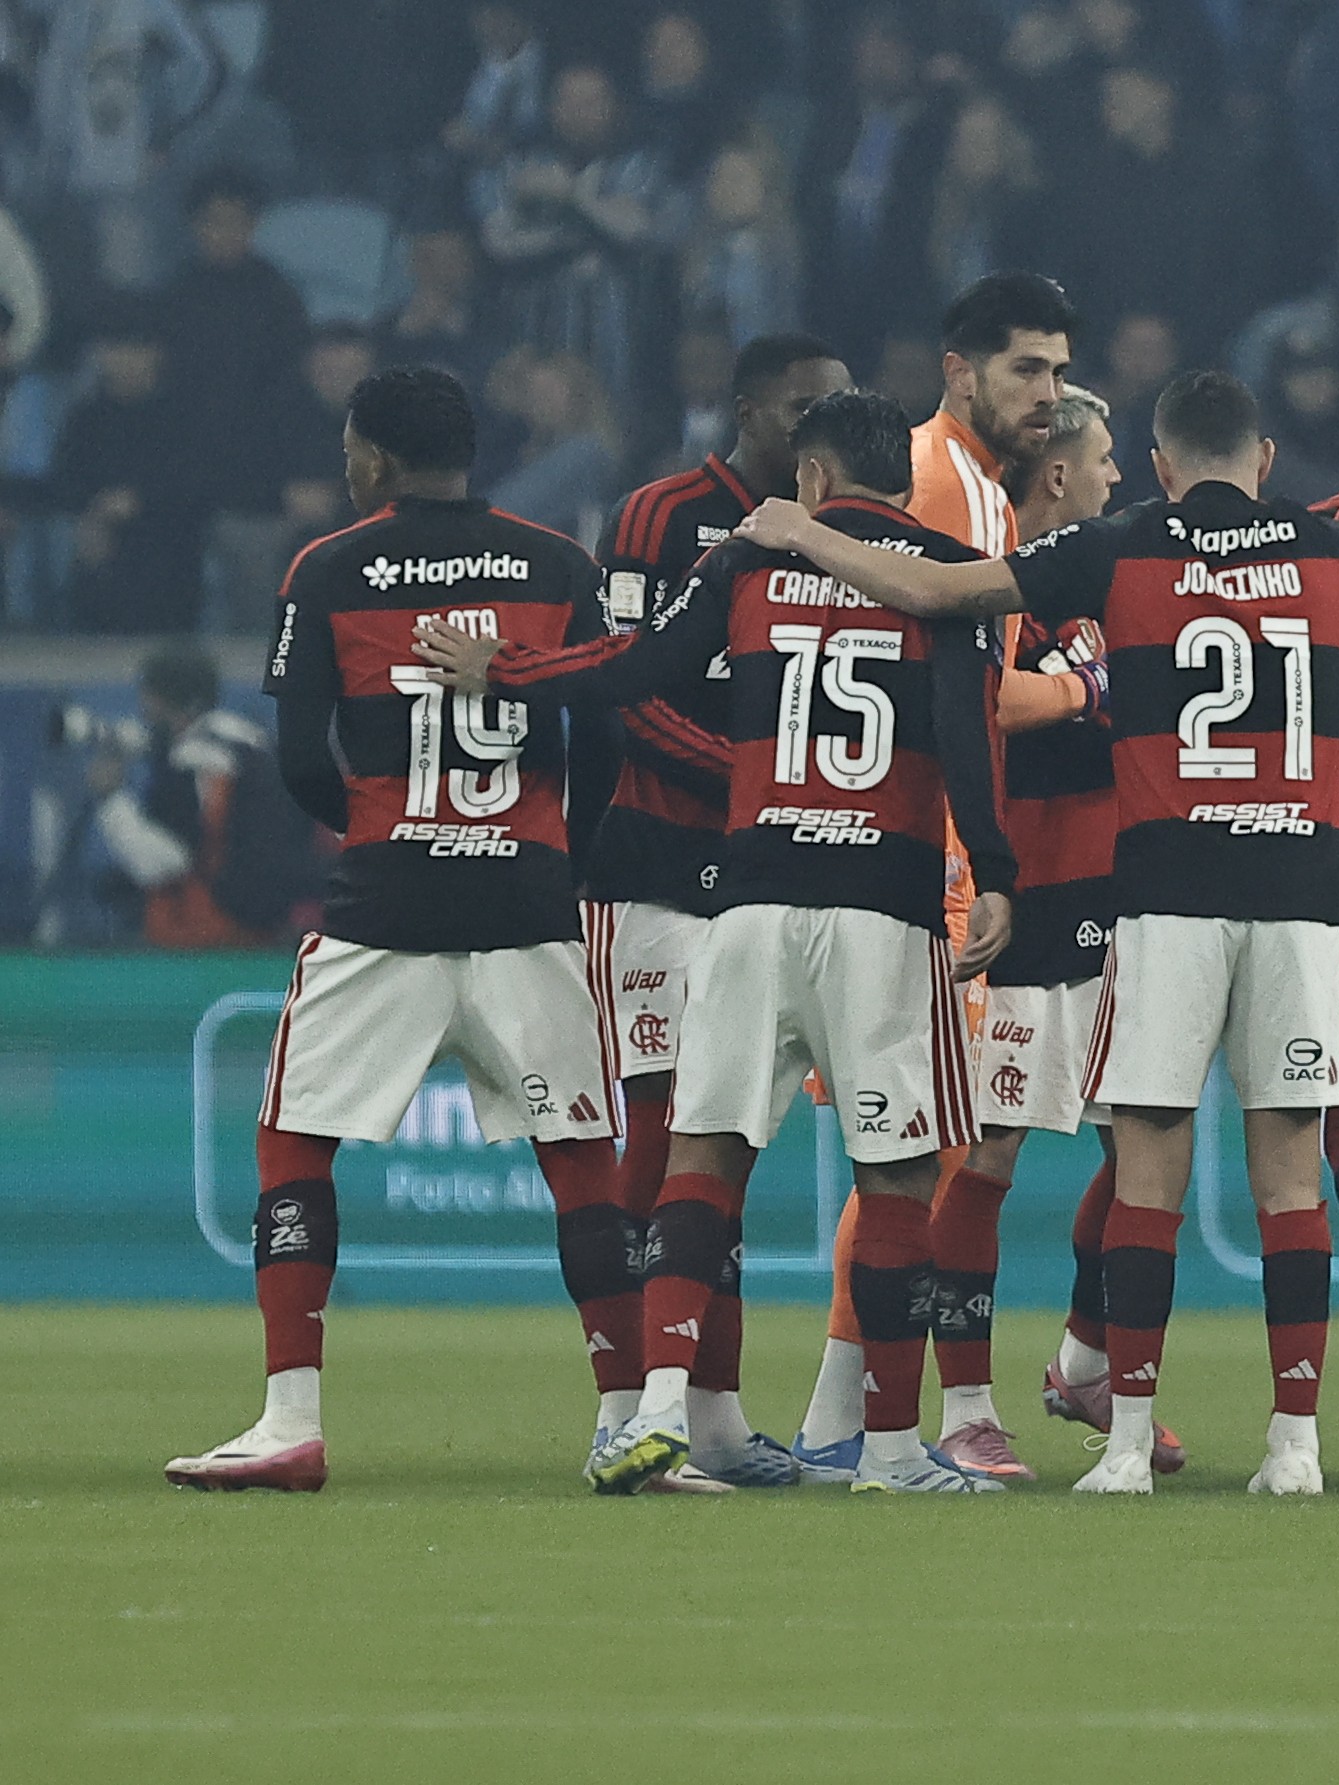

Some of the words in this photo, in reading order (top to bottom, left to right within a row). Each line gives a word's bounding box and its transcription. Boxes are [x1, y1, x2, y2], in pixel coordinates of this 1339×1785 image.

[403, 551, 529, 586] Hapvida
[766, 569, 883, 609] CARRAS
[272, 602, 297, 677] Shopee
[416, 608, 499, 648] POTA
[852, 638, 896, 650] TEXACO
[1234, 643, 1242, 685] TEXACO
[790, 674, 803, 717] TEXACO
[1175, 616, 1314, 781] 21
[1294, 669, 1303, 713] TEXACO
[769, 624, 904, 791] 15
[391, 665, 528, 819] 19
[756, 807, 876, 828] ASSIST
[1188, 803, 1310, 823] ASSIST
[1229, 818, 1317, 837] CARD
[389, 823, 511, 841] ASSIST
[792, 826, 882, 845] CARD
[428, 839, 519, 857] CARD
[622, 968, 667, 993] Wap
[991, 1020, 1035, 1048] Wap
[1282, 1067, 1326, 1081] GAC
